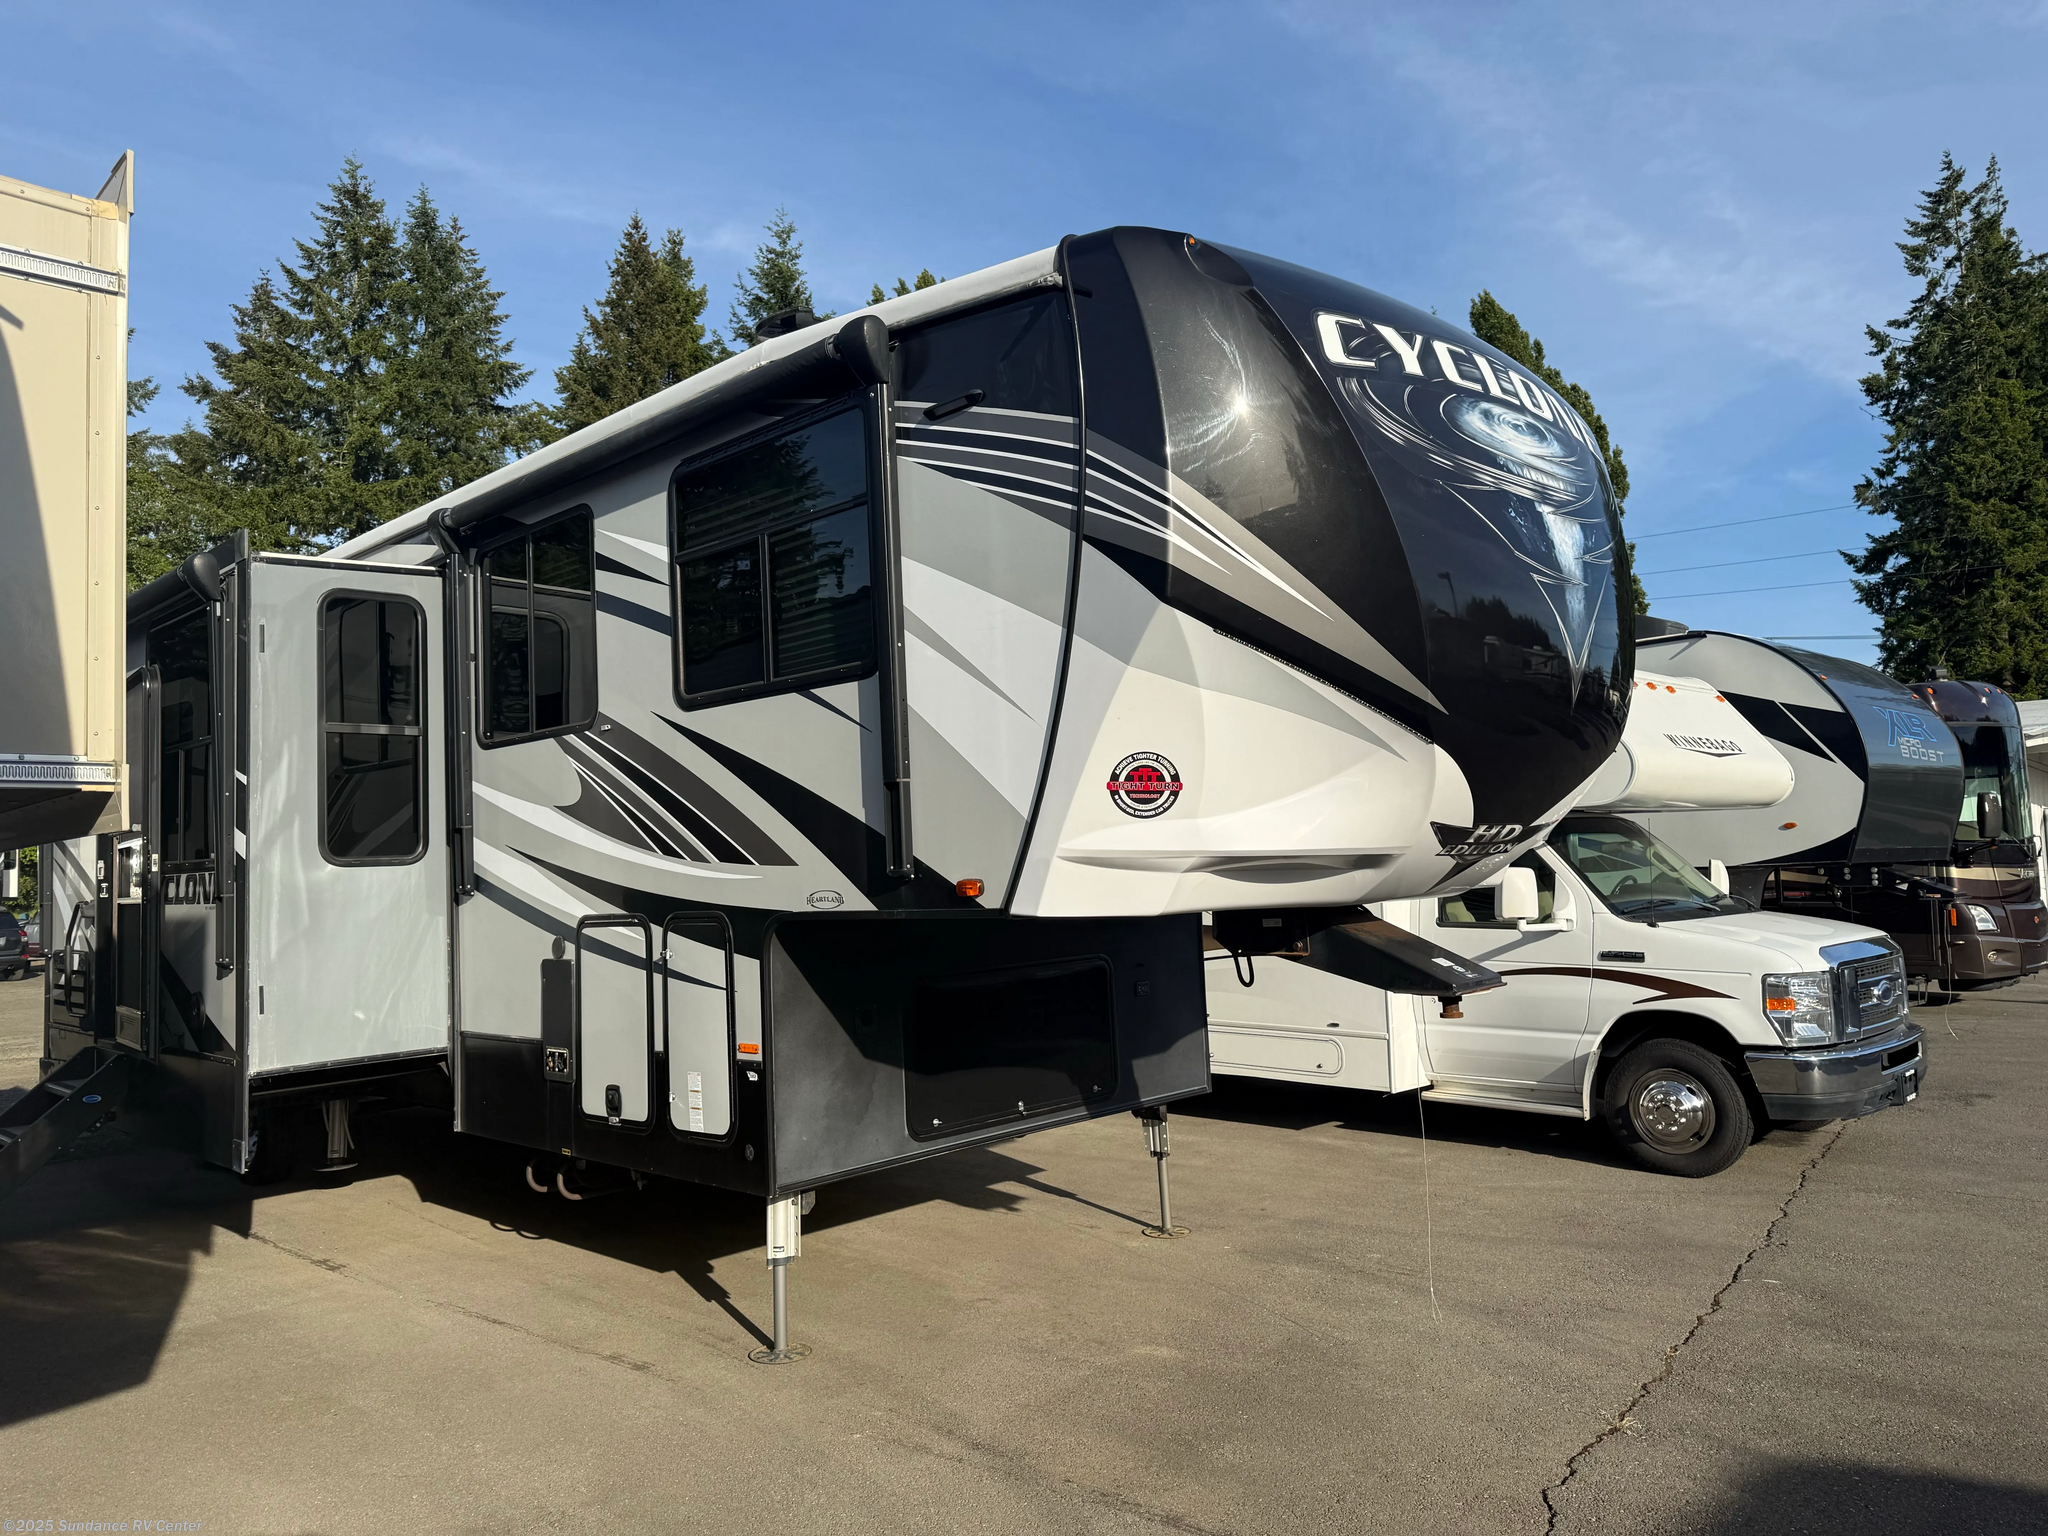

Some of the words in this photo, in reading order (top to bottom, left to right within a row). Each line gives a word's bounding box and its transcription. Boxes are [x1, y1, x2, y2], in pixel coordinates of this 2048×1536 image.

[1312, 311, 1603, 464] CYCLONE
[1873, 705, 1938, 747] XLR
[1662, 732, 1743, 753] WINNEBAGO
[1114, 756, 1134, 775] ACHIEVE
[1132, 752, 1158, 761] TIGHTER
[1157, 756, 1177, 776] TURNING
[1900, 745, 1944, 763] BOOST
[1110, 781, 1145, 791] TIGHT
[1147, 781, 1180, 792] TURN
[1464, 824, 1524, 843] HD
[1438, 842, 1518, 856] EDITION
[162, 872, 217, 905] CLON
[806, 895, 845, 906] HEARTLAND
